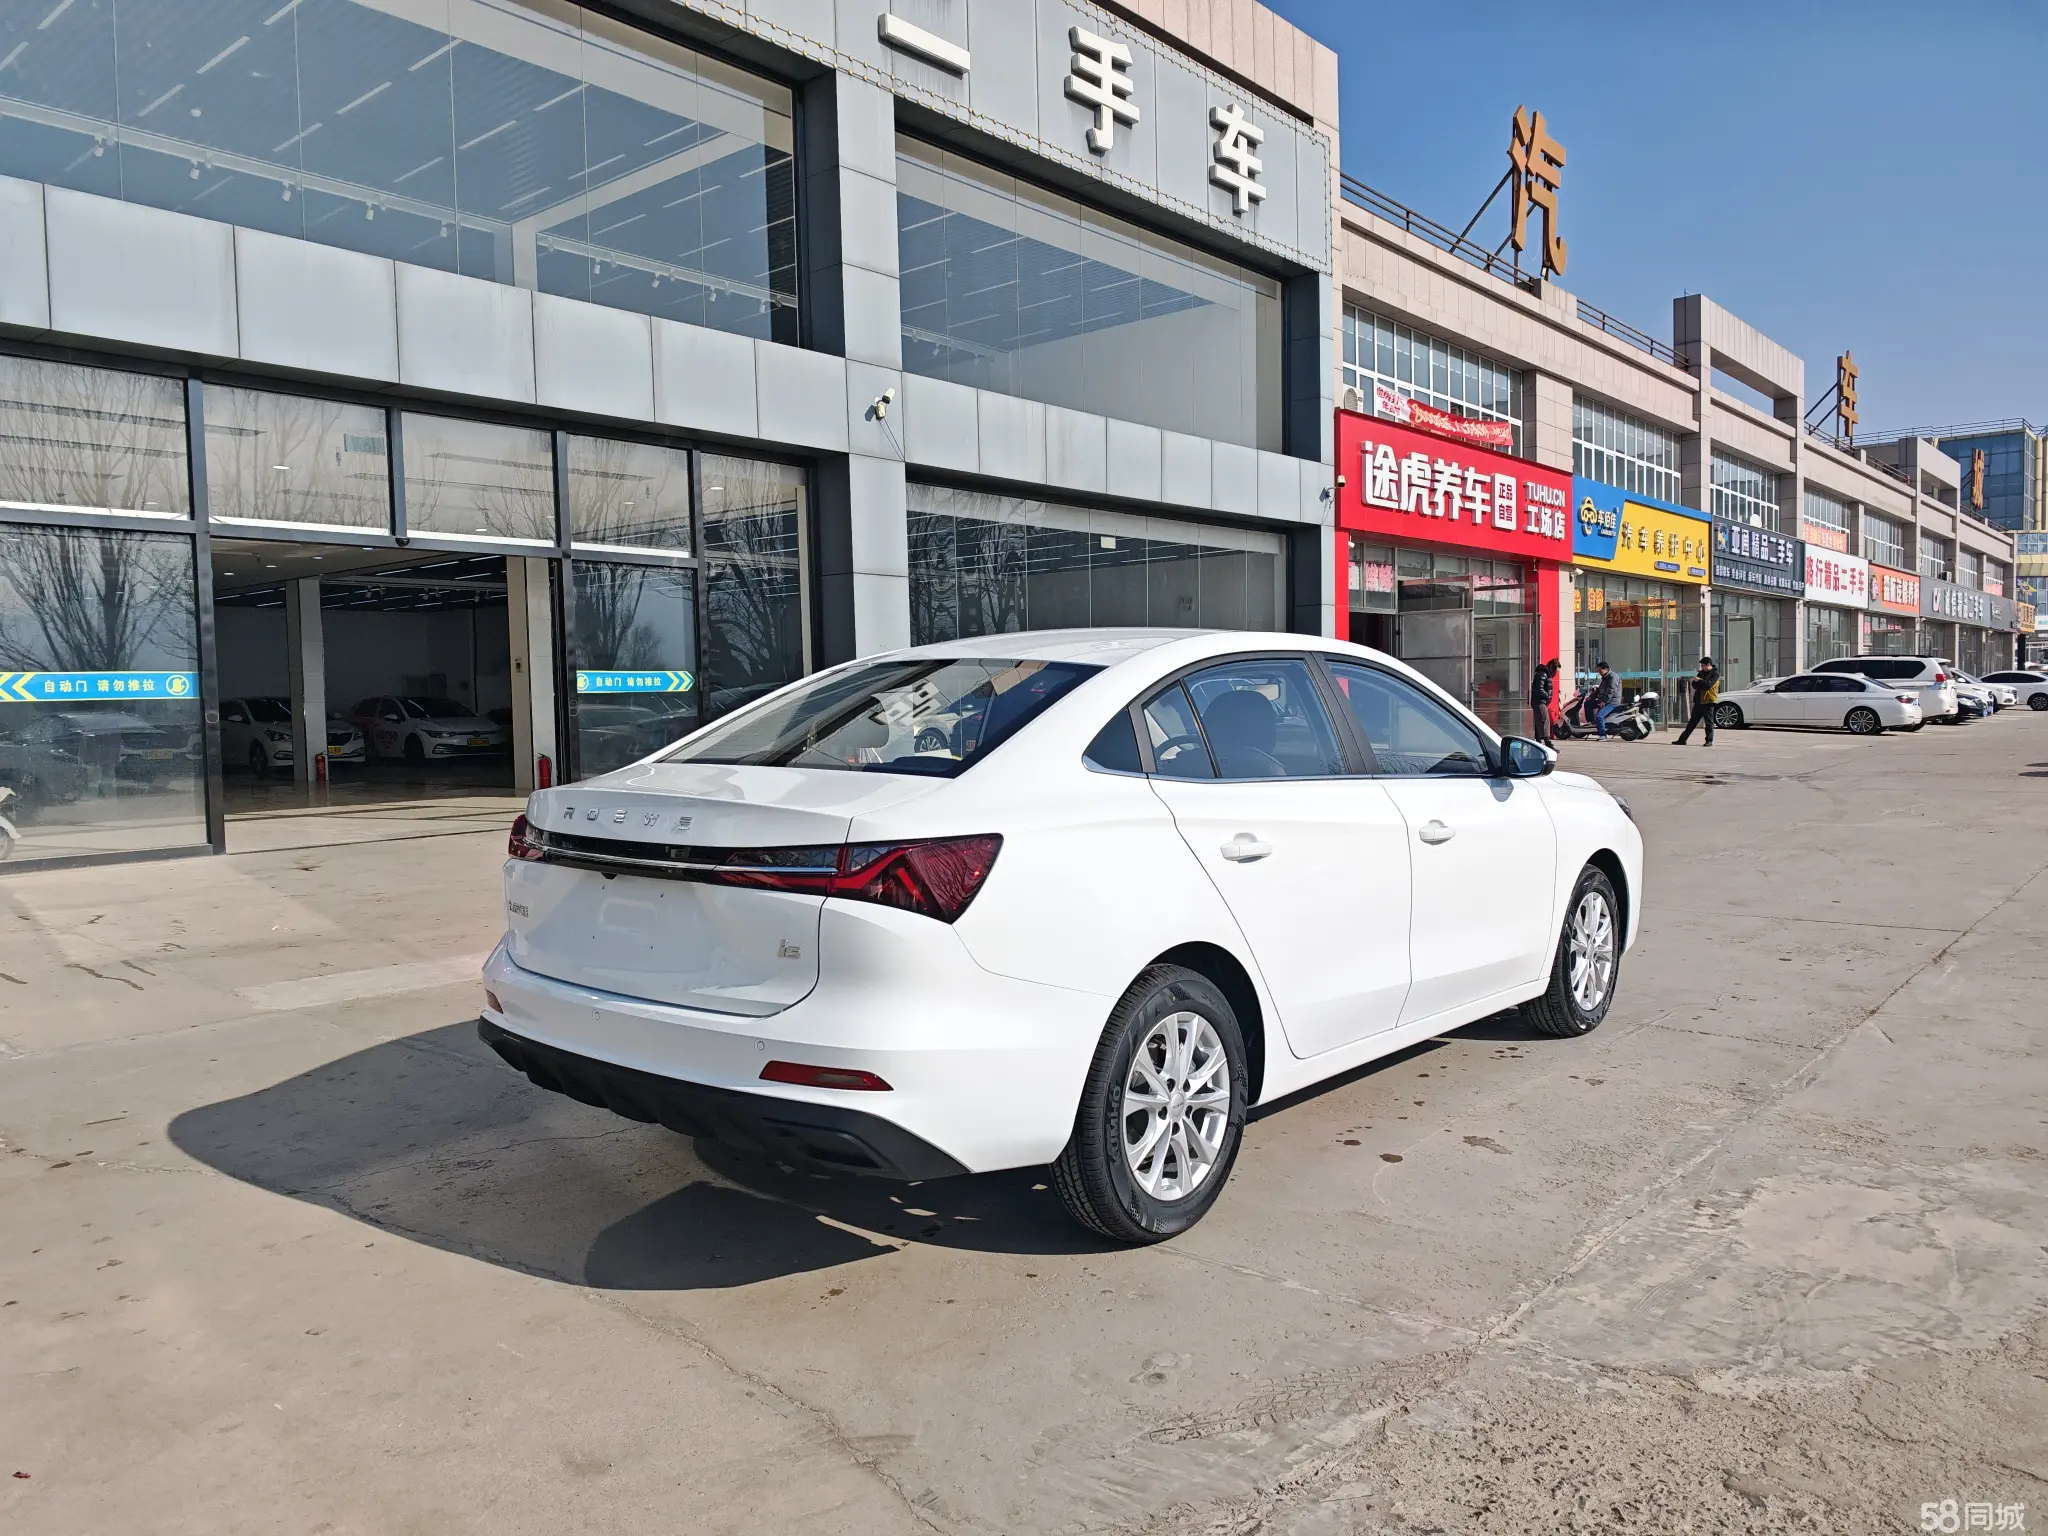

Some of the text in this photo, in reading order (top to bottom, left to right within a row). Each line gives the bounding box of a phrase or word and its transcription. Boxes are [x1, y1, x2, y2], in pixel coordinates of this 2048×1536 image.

[1507, 104, 1567, 276] 汽
[1838, 350, 1858, 437] 车
[1362, 440, 1491, 524] 途虎养车
[1500, 483, 1513, 501] 正品
[1525, 481, 1566, 508] TUHU.CN
[1499, 504, 1513, 522] 自营
[1525, 505, 1566, 540] 工场店
[1621, 520, 1705, 564] 汽车养护中心
[1731, 525, 1794, 567] 亚通精品二手车
[44, 679, 156, 693] 自动门 请勿推拉
[596, 677, 662, 687] 自动门 请勿推拉
[563, 806, 692, 831] ROEWE
